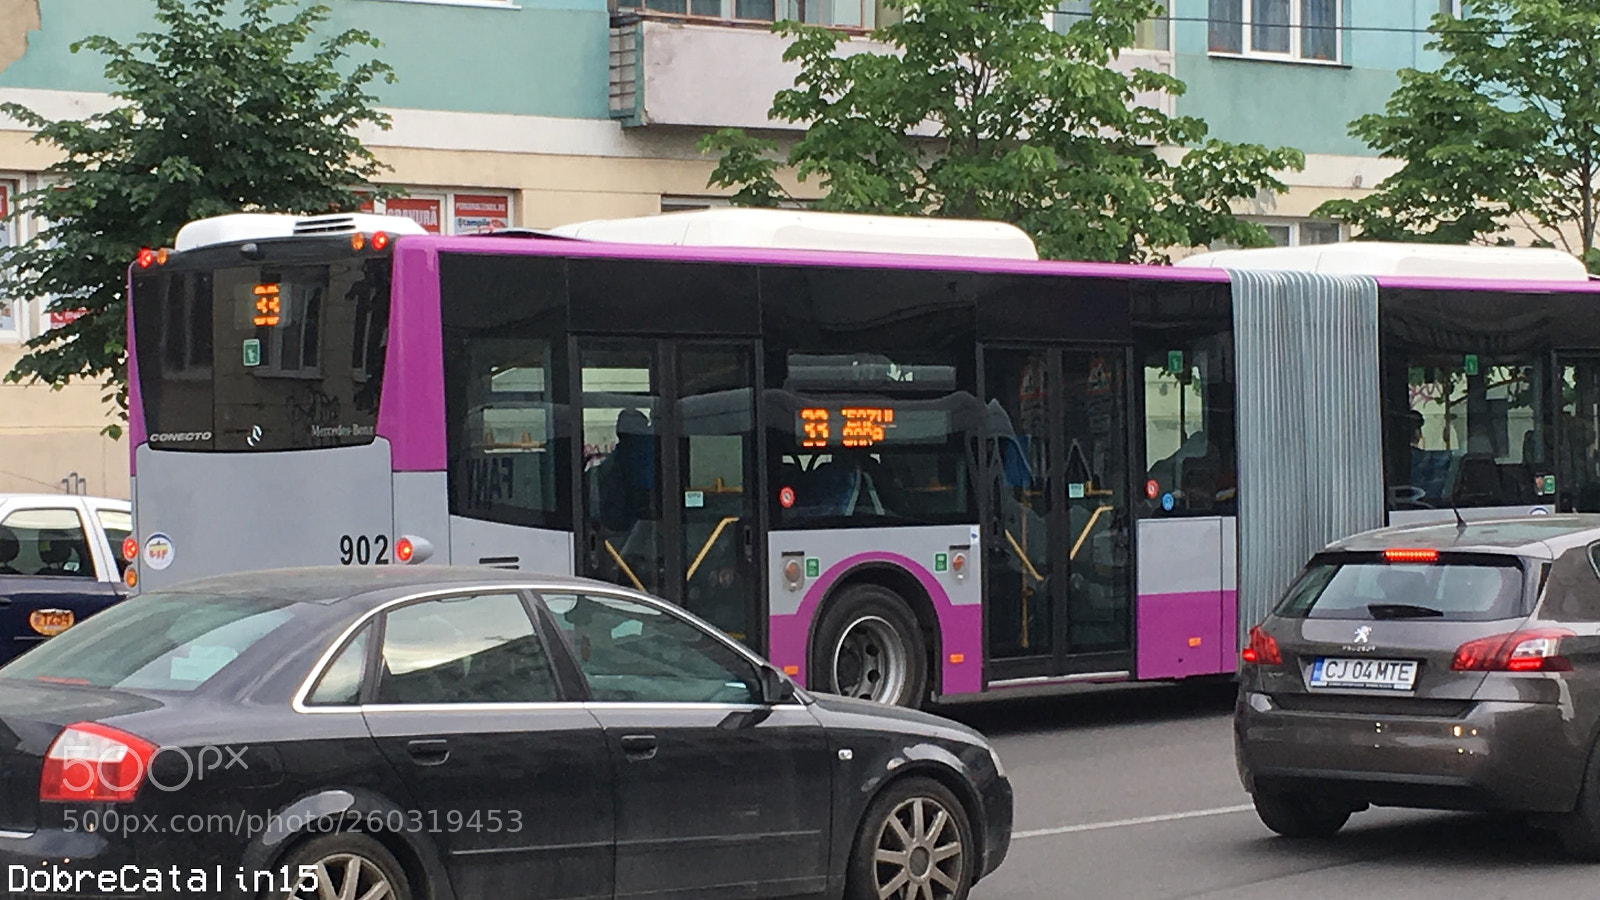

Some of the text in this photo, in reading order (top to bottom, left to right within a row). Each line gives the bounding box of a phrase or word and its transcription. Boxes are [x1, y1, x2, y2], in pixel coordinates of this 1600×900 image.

[253, 284, 280, 326] 33
[149, 431, 213, 442] CONECTO
[311, 424, 374, 437] Mercedes-Benz
[801, 408, 829, 446] 33
[340, 534, 389, 566] 902
[1325, 660, 1413, 682] CJ 04 MTE
